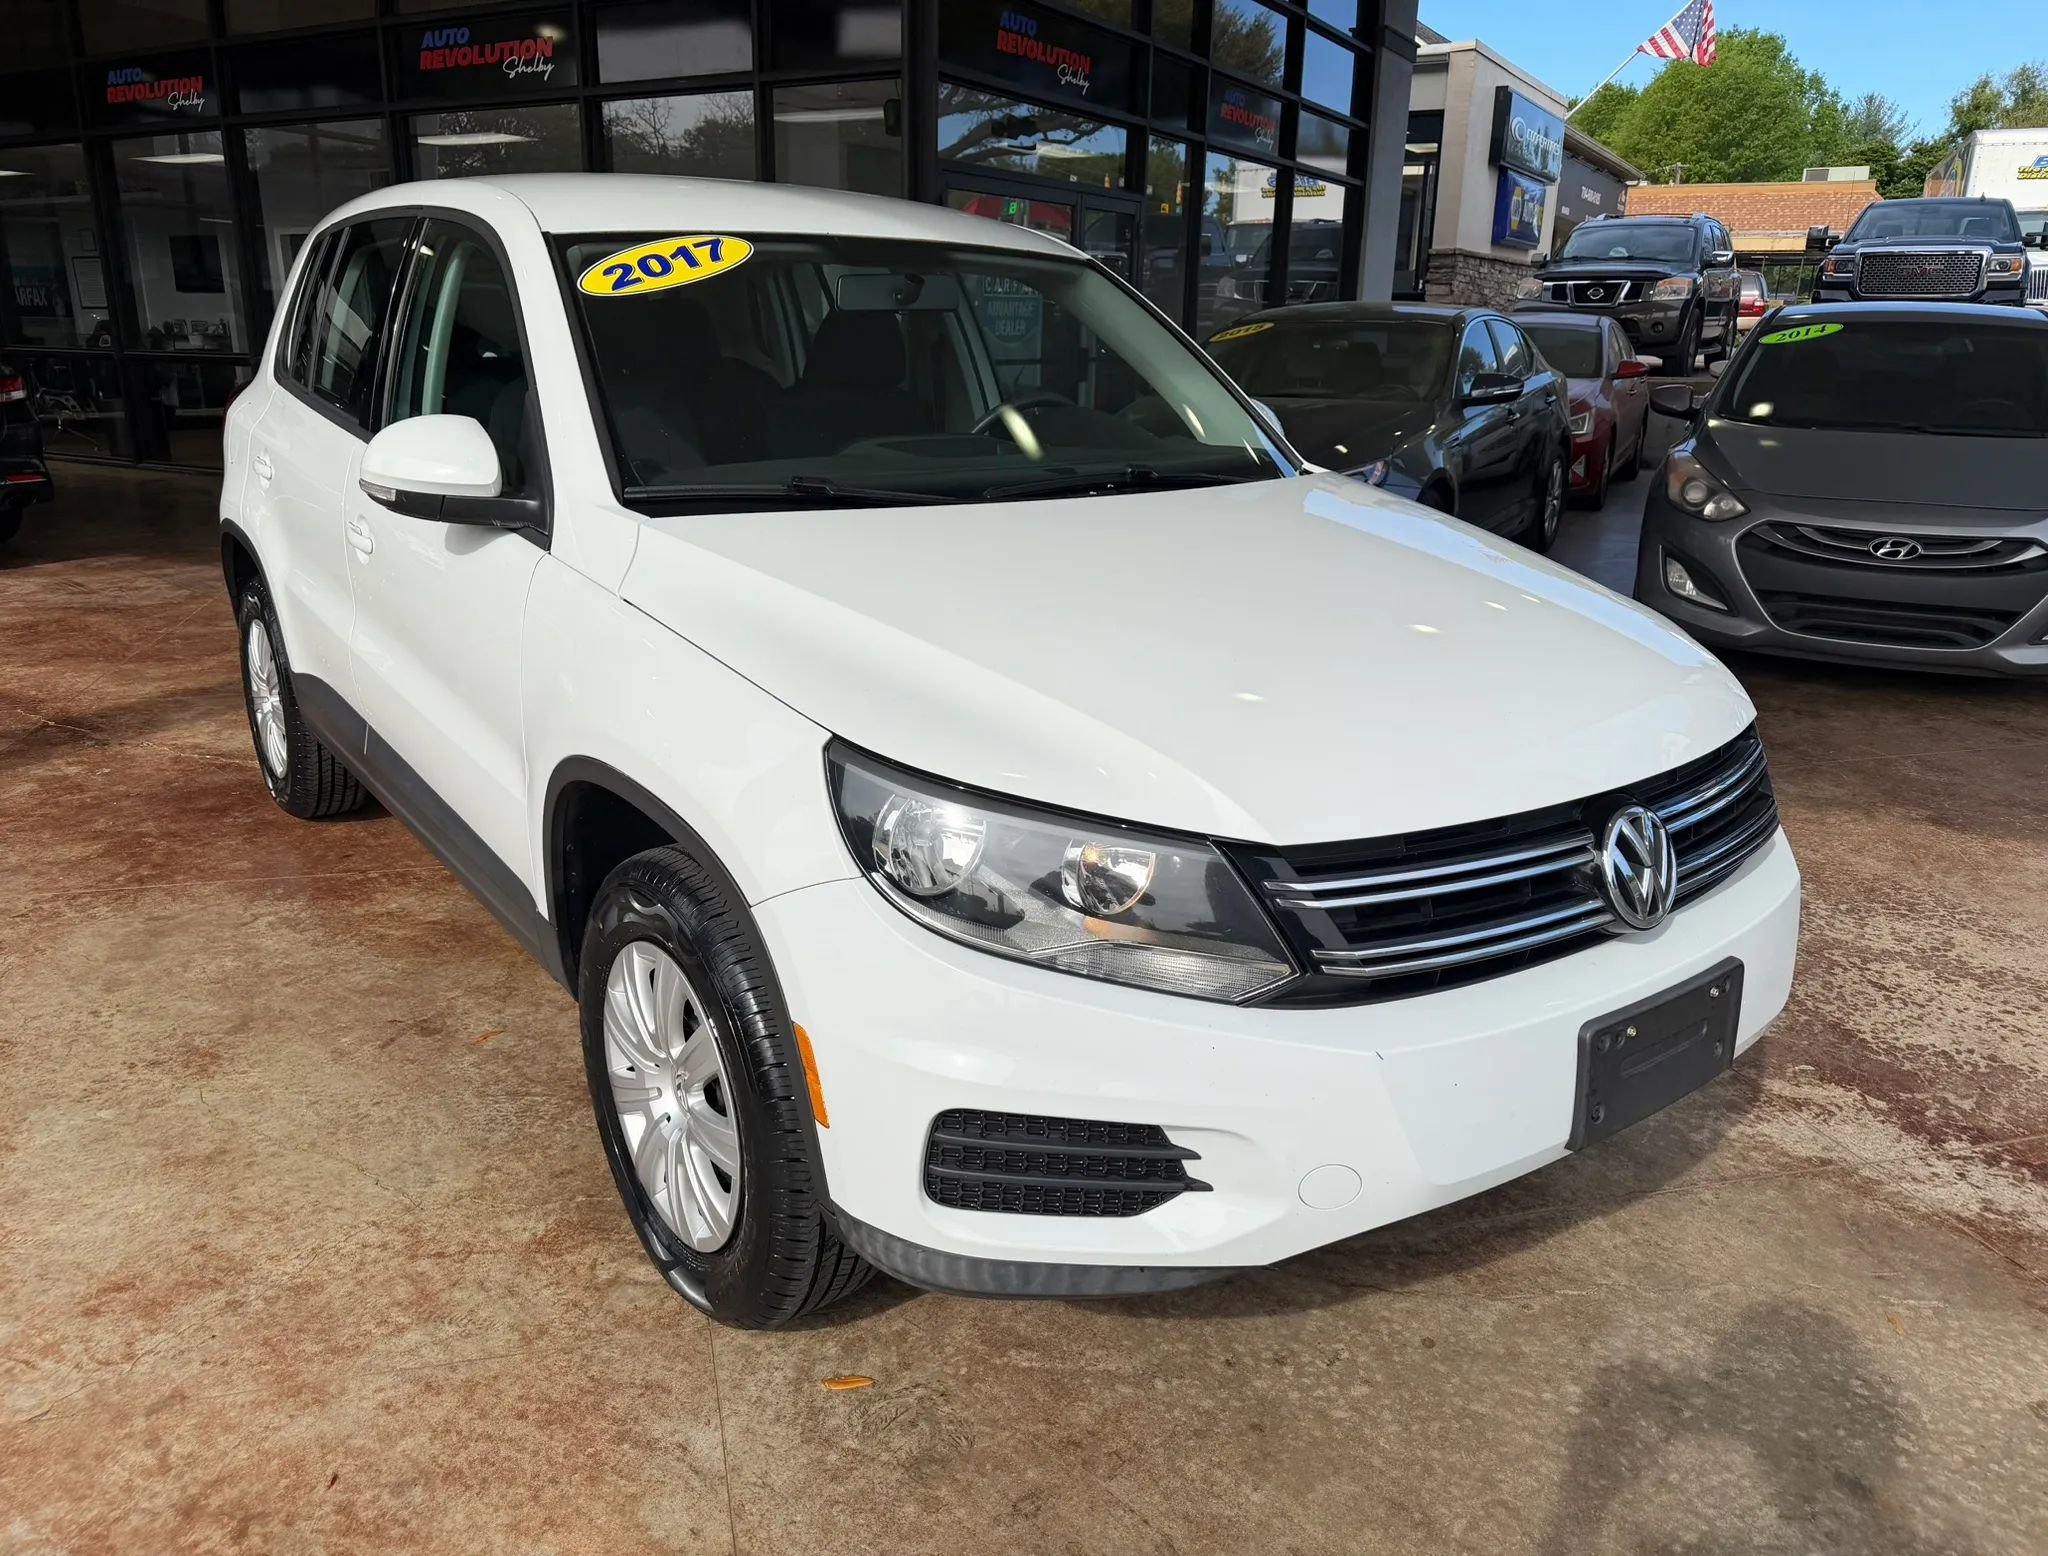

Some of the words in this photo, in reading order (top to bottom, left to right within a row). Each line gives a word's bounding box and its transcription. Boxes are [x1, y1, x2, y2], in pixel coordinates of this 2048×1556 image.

[999, 11, 1037, 37] AUTO
[421, 28, 470, 48] AUTO
[419, 37, 553, 70] REVOLUTION
[997, 31, 1092, 75] REVOLUTION
[107, 68, 142, 85] AUTO
[502, 53, 555, 81] Shelby
[1057, 64, 1090, 96] Shelby
[106, 75, 203, 104] REVOLUTION
[168, 90, 205, 112] Shelby
[1221, 104, 1276, 132] REVOLUTION
[603, 239, 723, 291] 2017
[987, 301, 1033, 317] ADVANTAGE
[995, 319, 1026, 336] DEALER
[1775, 325, 1826, 342] 2014
